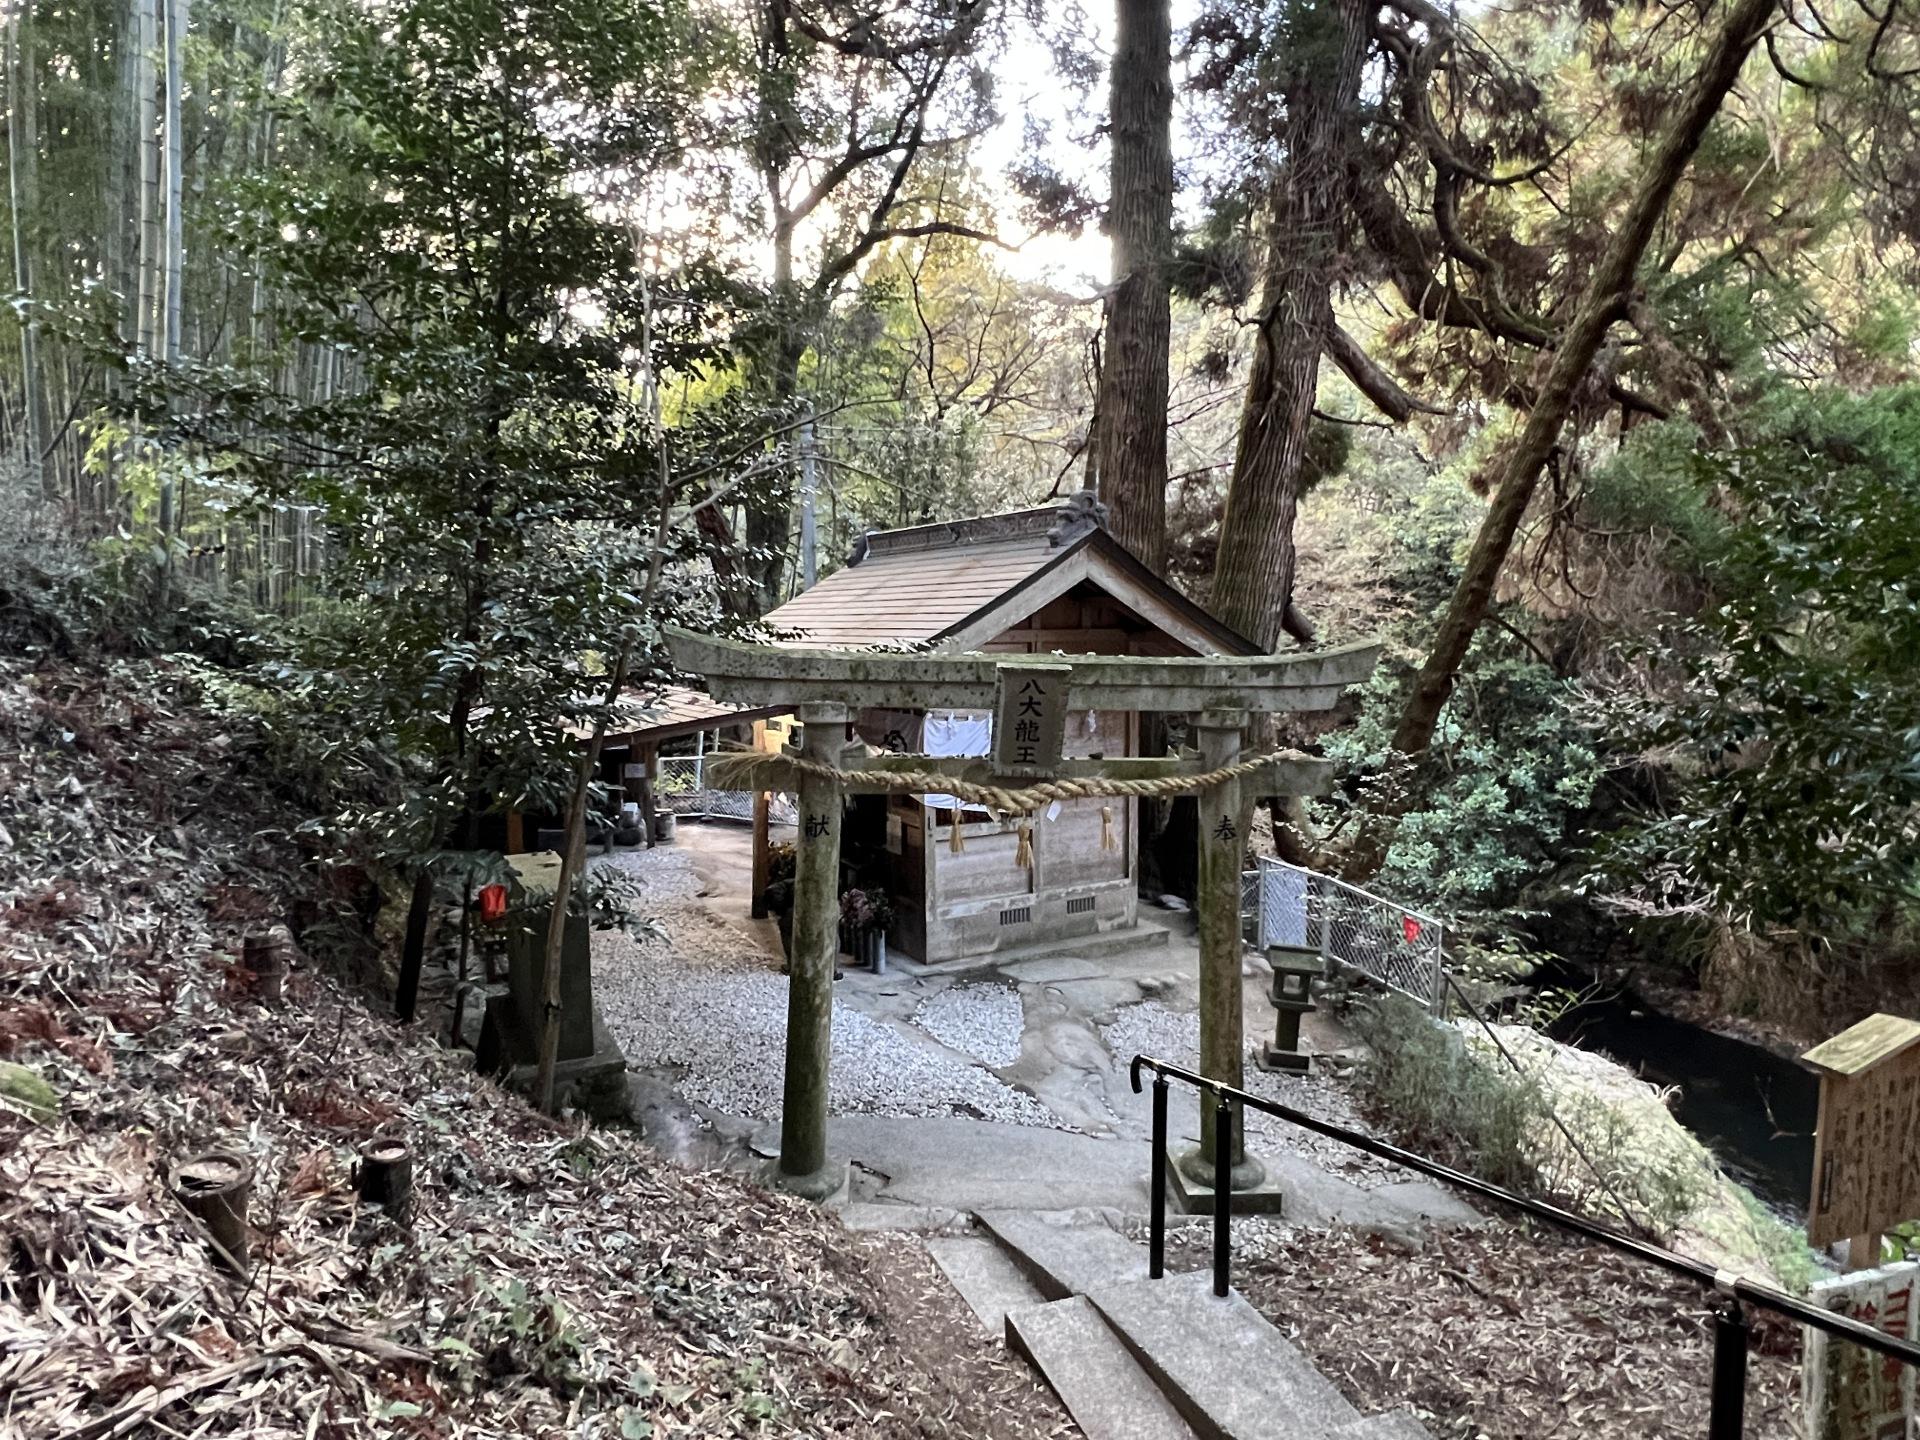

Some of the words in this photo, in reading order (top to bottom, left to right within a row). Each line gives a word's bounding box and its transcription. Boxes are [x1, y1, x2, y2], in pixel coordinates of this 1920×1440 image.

[1013, 678, 1046, 765] 八大龍王
[804, 813, 830, 840] 献
[1213, 814, 1238, 844] 奉
